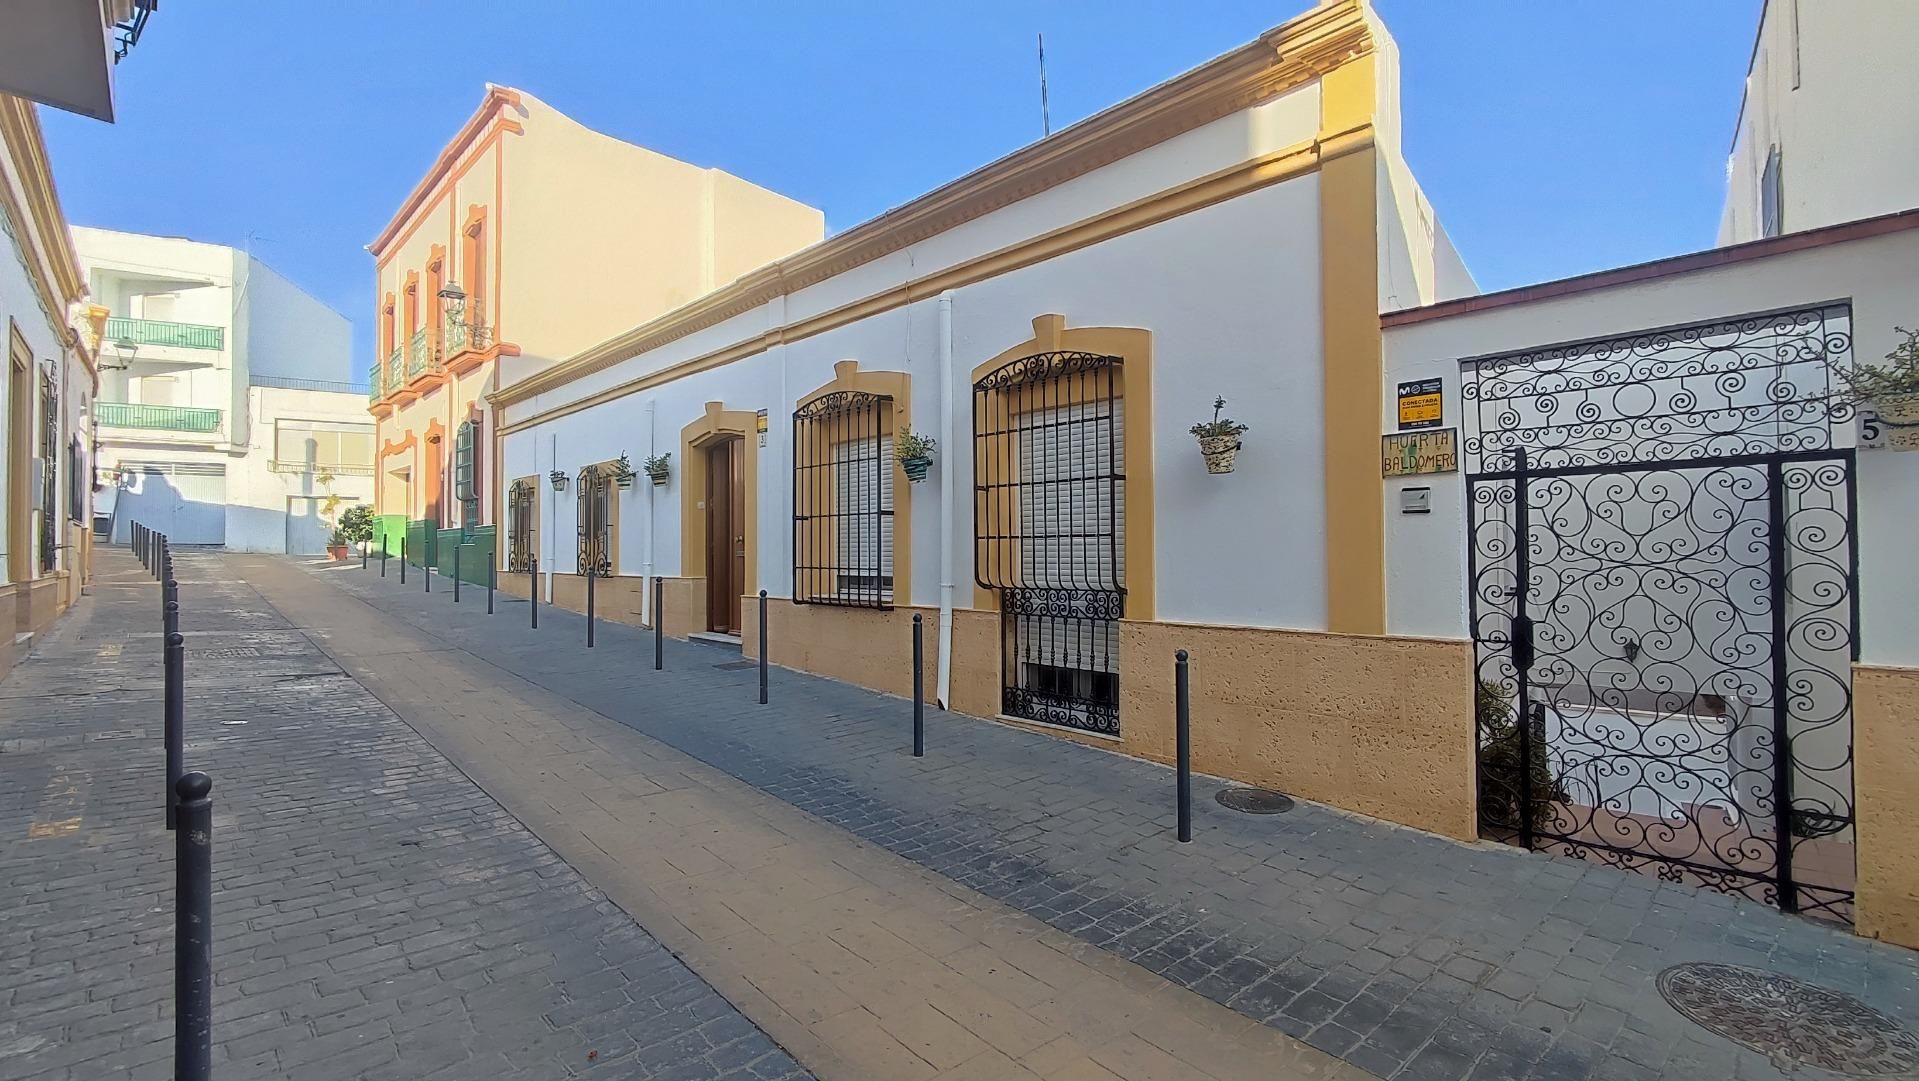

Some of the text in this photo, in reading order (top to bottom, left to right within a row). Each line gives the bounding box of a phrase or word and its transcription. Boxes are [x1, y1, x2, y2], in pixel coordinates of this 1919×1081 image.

[1402, 398, 1438, 406] CONECTADA
[1862, 419, 1879, 440] 5
[1391, 432, 1448, 449] HUERTA
[1384, 453, 1457, 472] BALDOMERO
